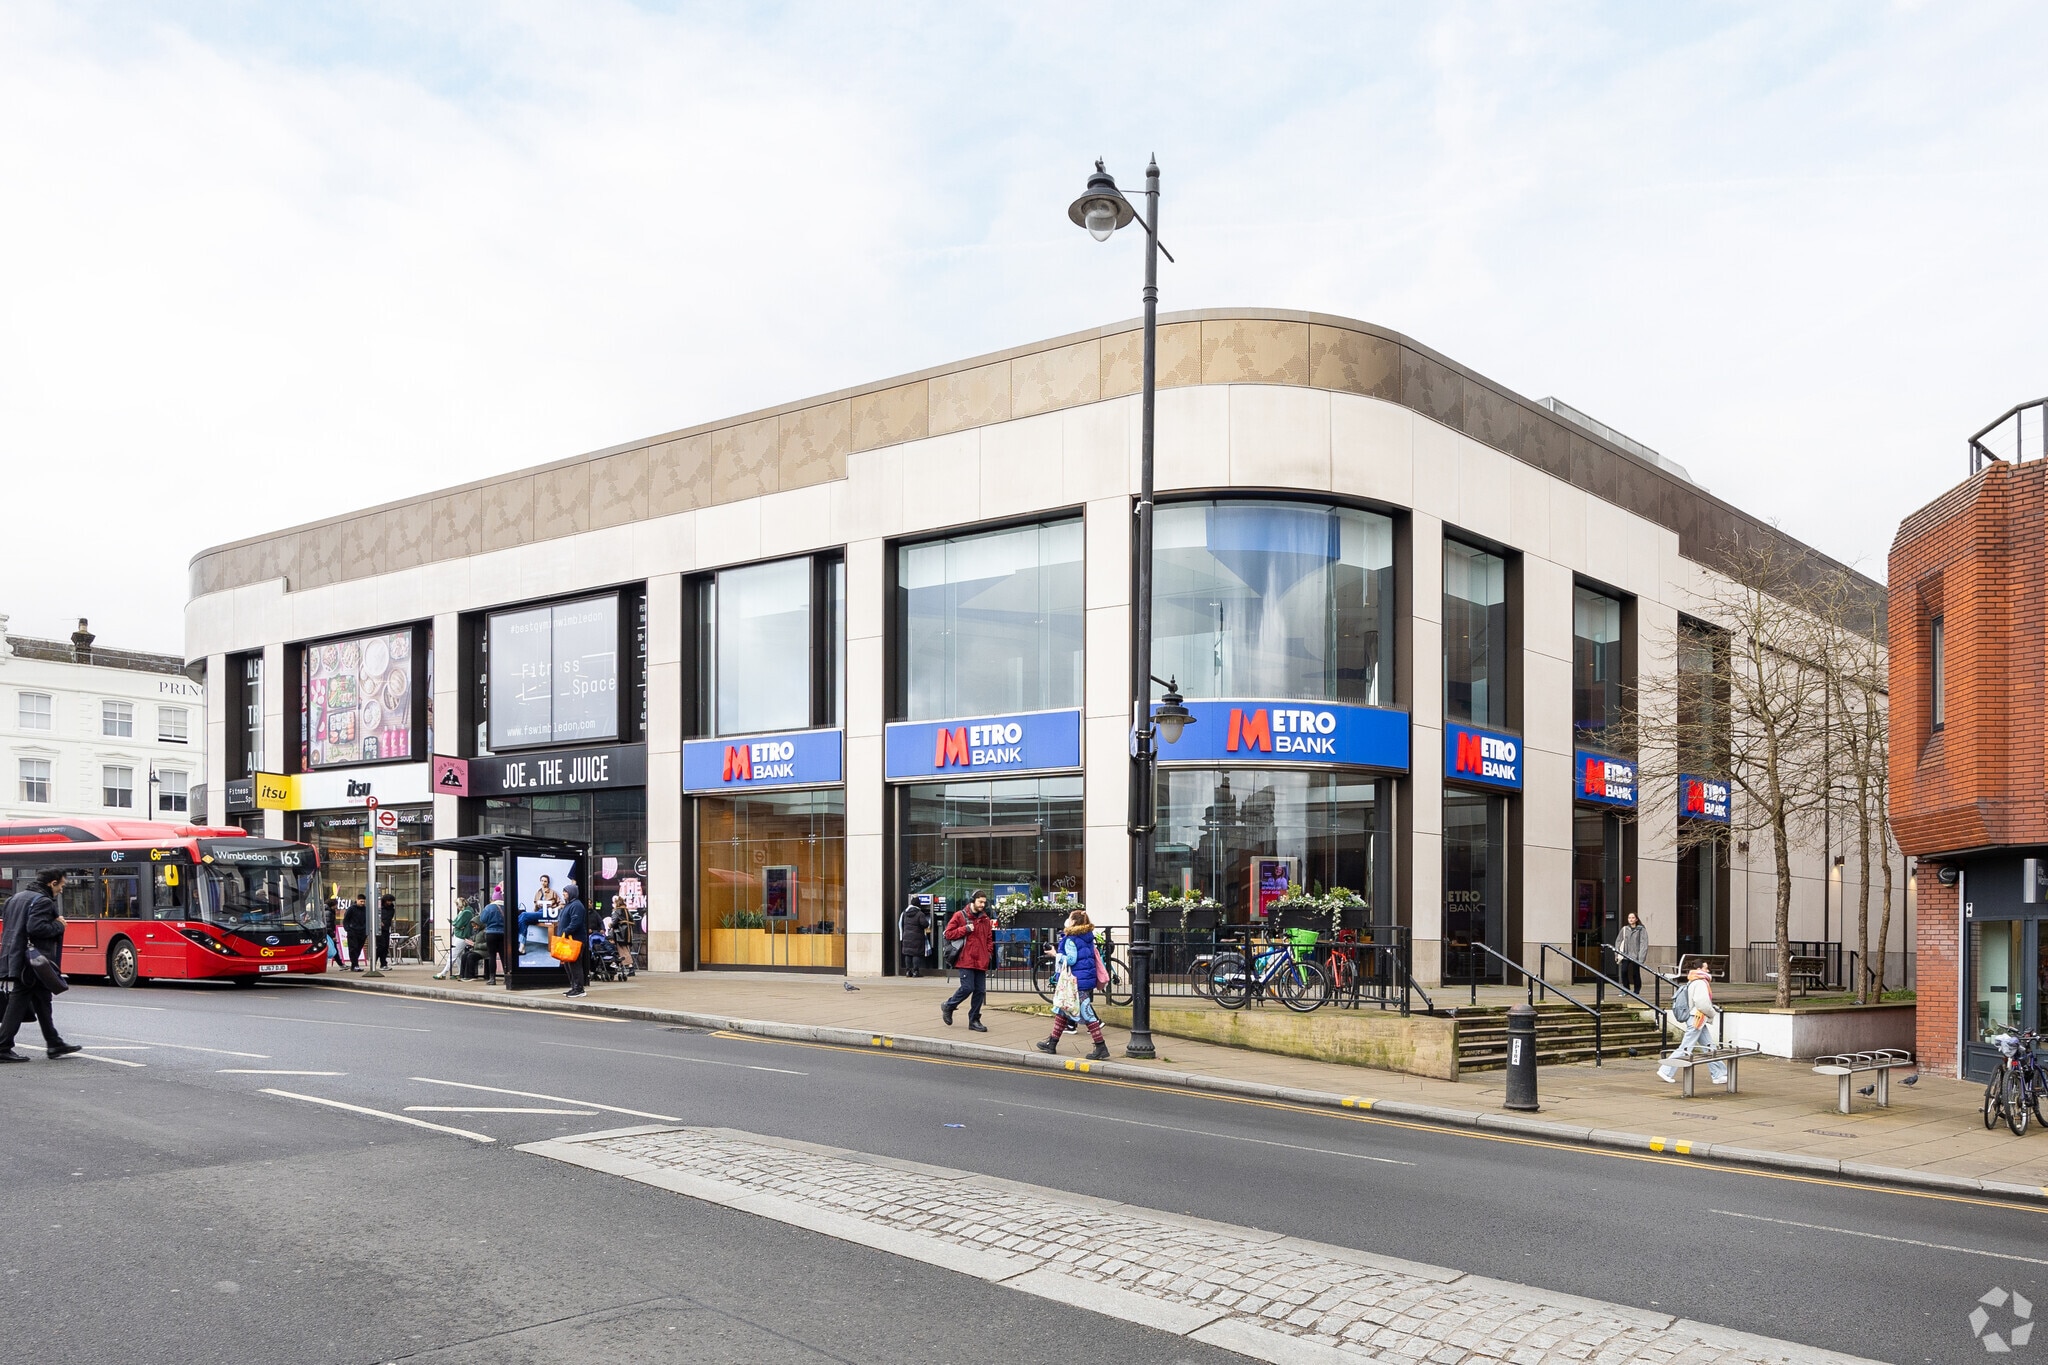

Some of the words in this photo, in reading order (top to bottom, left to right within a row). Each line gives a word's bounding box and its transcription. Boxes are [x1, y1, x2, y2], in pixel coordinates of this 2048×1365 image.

[572, 678, 616, 698] Space
[1226, 708, 1336, 752] METRO
[935, 723, 1022, 768] METRO
[1276, 736, 1336, 754] BANK
[1456, 732, 1516, 775] METRO
[723, 741, 794, 781] METRO
[972, 747, 1022, 765] BANK
[502, 762, 526, 788] JOE
[530, 778, 538, 786] &
[538, 759, 563, 786] THE
[569, 756, 608, 784] JUICE
[754, 763, 795, 780] BANK
[1483, 761, 1516, 780] BANK
[1585, 758, 1632, 797] METRO
[262, 785, 287, 800] itsu
[346, 779, 372, 798] itsu
[1606, 784, 1632, 800] BANK
[1688, 780, 1726, 814] METRO
[370, 798, 376, 806] P
[342, 817, 357, 825] salads
[400, 815, 415, 823] soups
[217, 851, 268, 861] Wimbledon
[281, 851, 300, 865] 163
[1450, 904, 1480, 912] BANK
